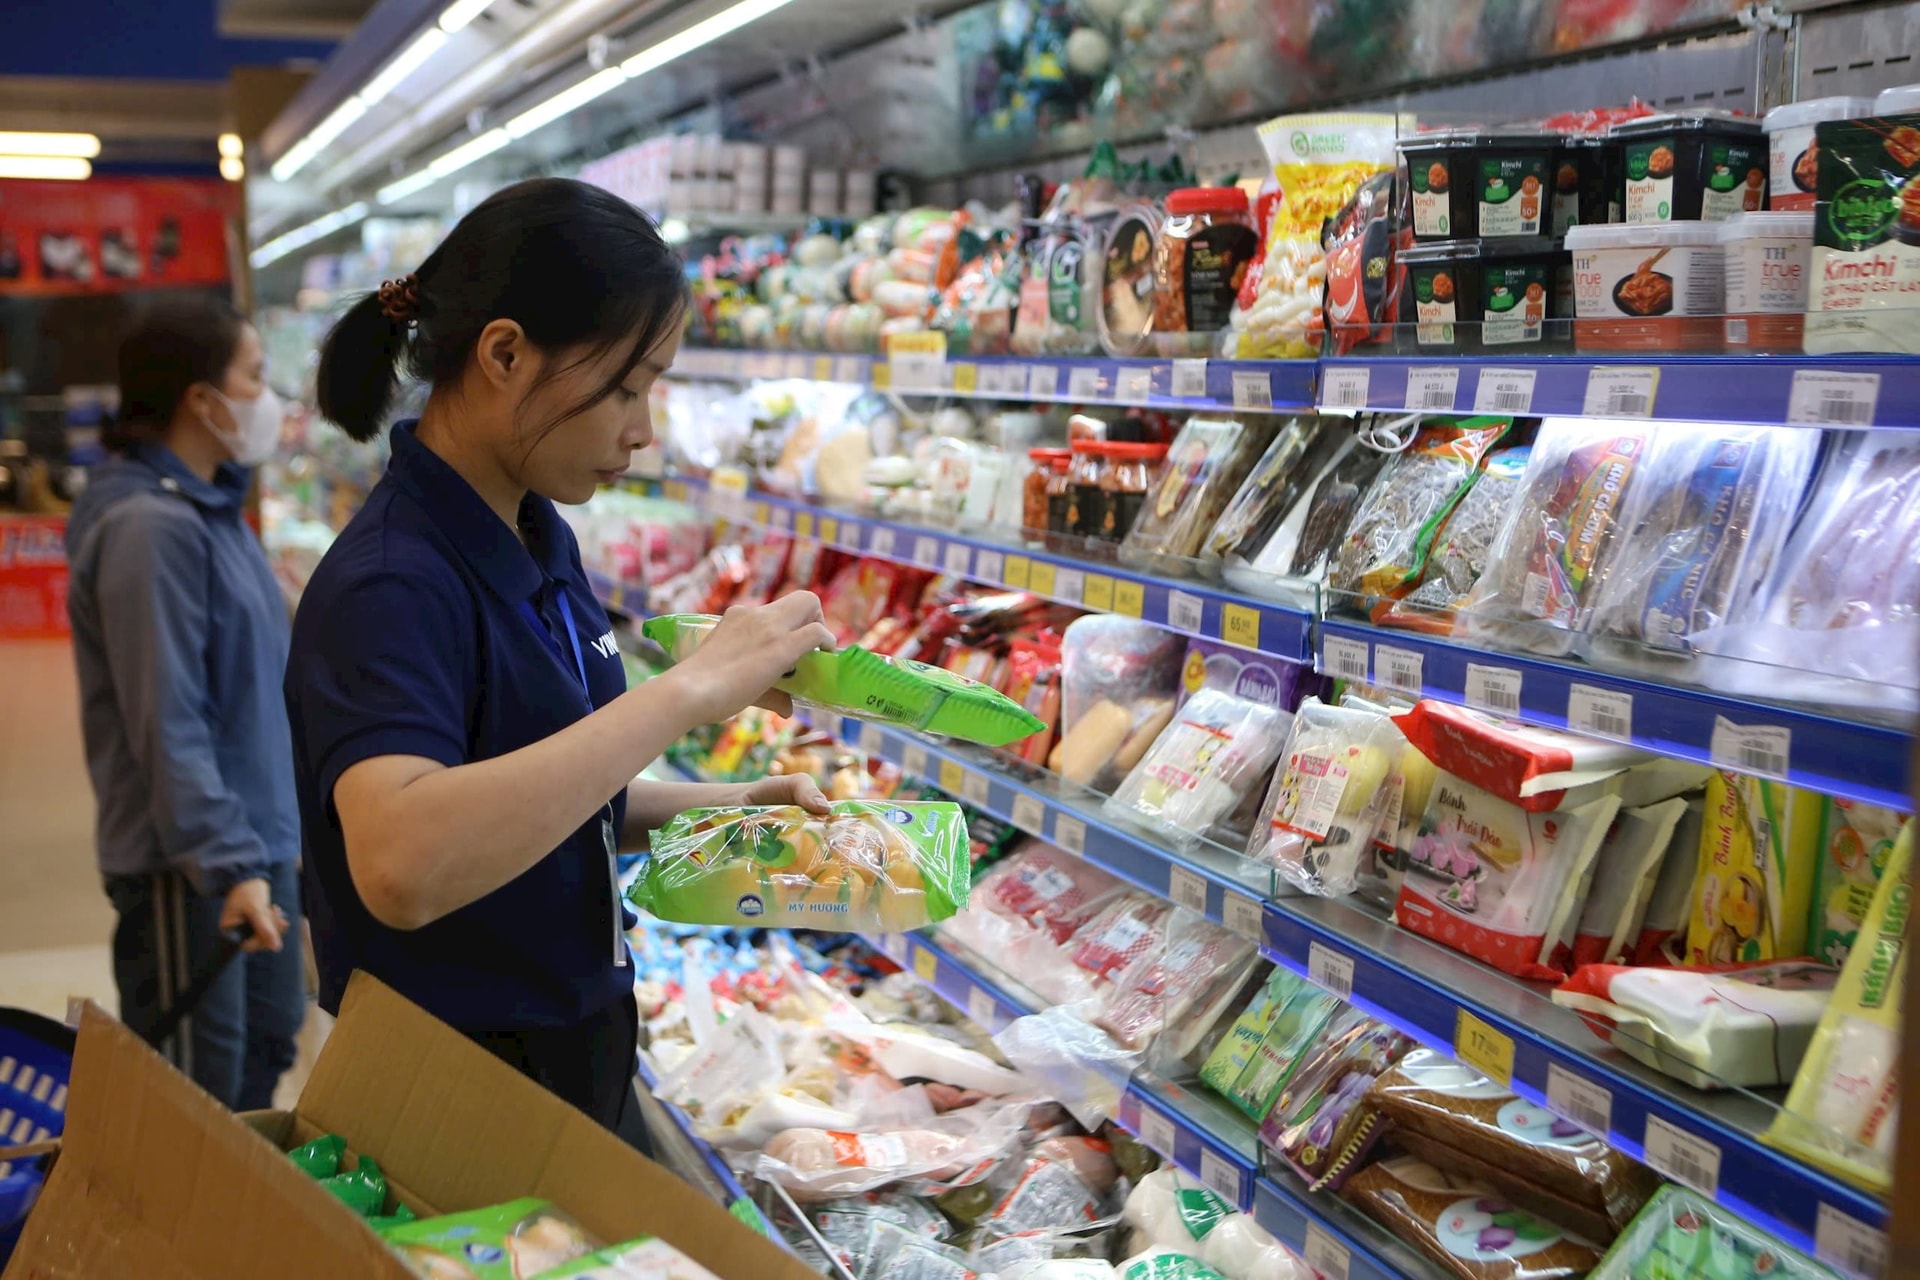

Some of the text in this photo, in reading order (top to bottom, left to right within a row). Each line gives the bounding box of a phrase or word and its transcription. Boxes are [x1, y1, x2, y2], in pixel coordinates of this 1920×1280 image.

[1501, 160, 1522, 169] Kimchi
[1628, 183, 1655, 195] Kimchi
[1415, 196, 1436, 208] Kimchi
[1763, 247, 1787, 260] TH
[1576, 258, 1590, 270] TH
[1762, 261, 1802, 277] true
[1824, 254, 1897, 280] Kimchi
[1504, 268, 1526, 277] Kimchi
[1575, 273, 1602, 285] true
[1760, 277, 1801, 291] FOOD
[1419, 305, 1442, 317] Kimchi
[1438, 787, 1467, 812] Bánh
[1713, 823, 1734, 867] Bánh
